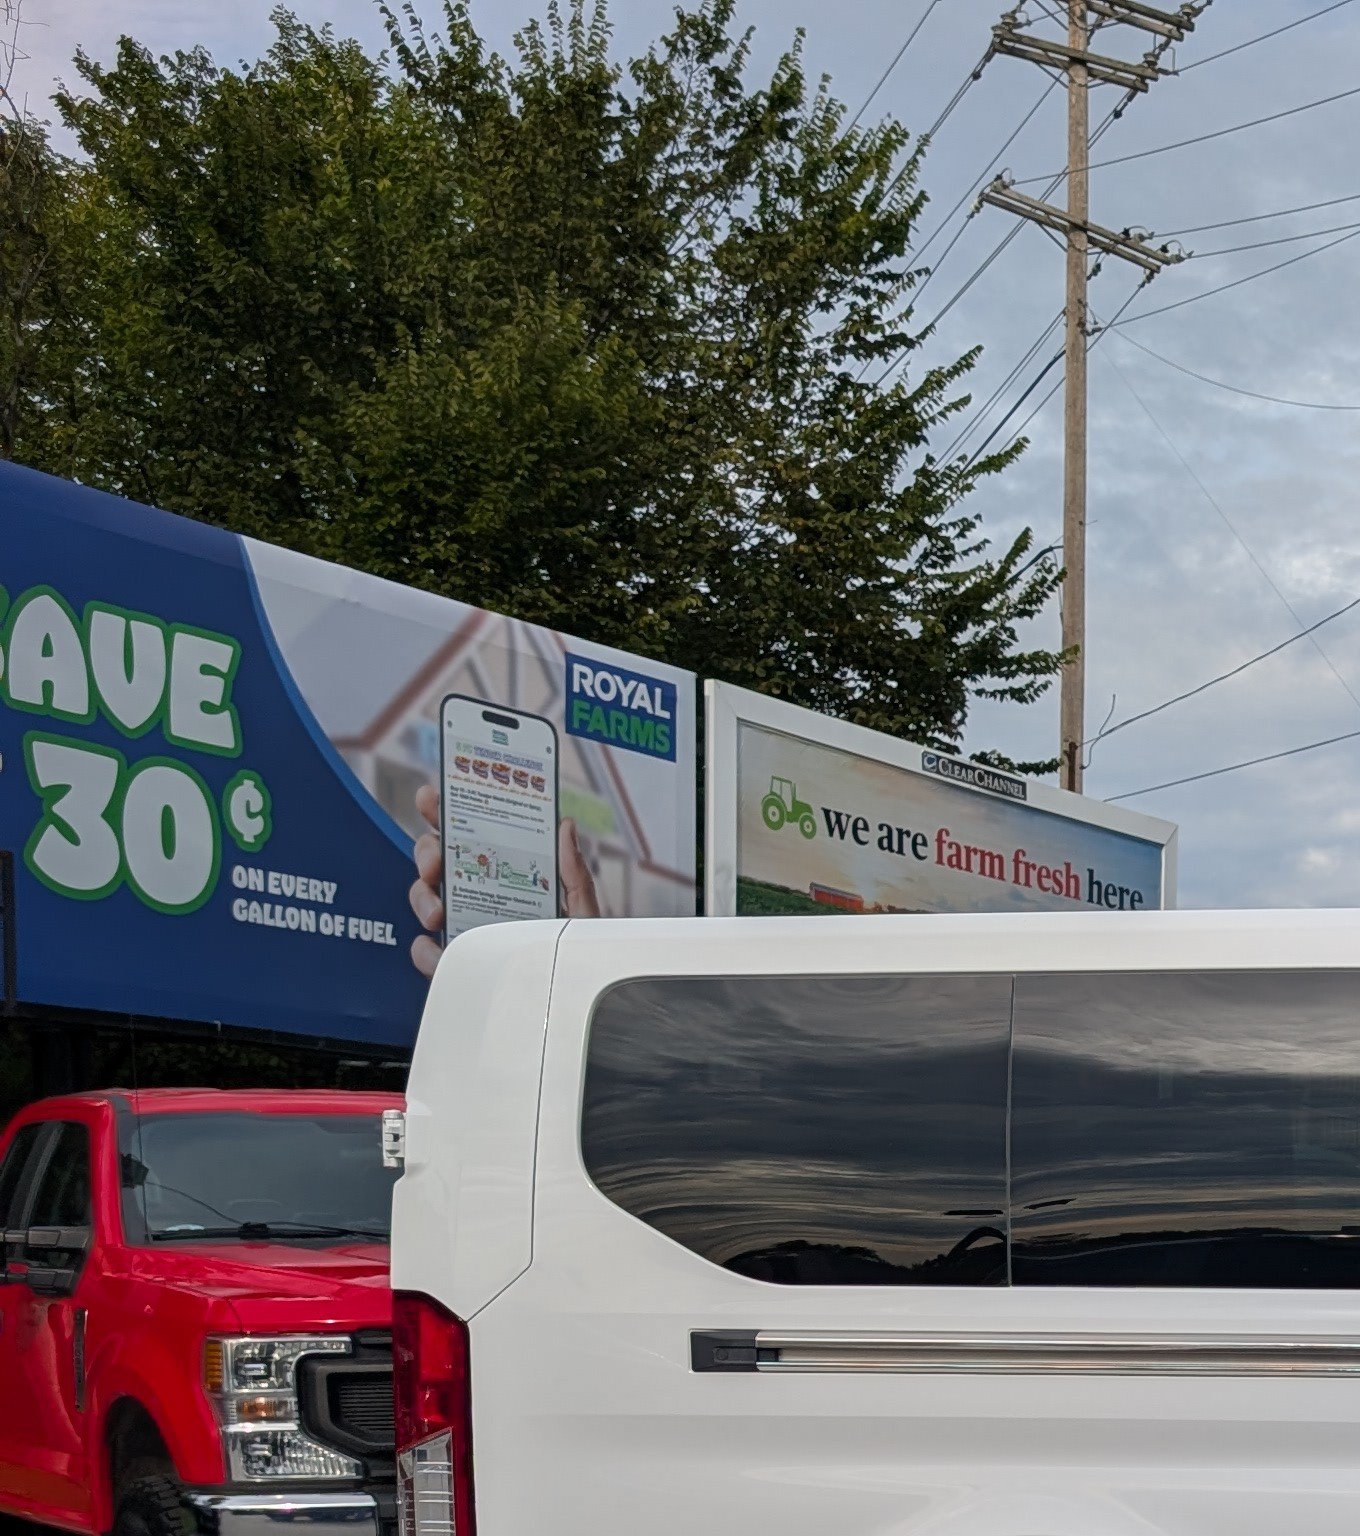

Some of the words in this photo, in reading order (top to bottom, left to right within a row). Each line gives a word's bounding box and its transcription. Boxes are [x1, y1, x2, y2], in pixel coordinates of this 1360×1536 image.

[0, 590, 238, 752] AVE
[572, 662, 671, 720] ROYAL
[572, 698, 671, 754] FARMS
[231, 864, 265, 893] ON
[267, 870, 338, 905] EVERY
[820, 806, 870, 846] we
[877, 822, 929, 861] are
[934, 827, 1007, 882] farm
[1012, 848, 1082, 901] fresh
[1086, 867, 1144, 910] here
[231, 897, 317, 934] GALLON
[319, 911, 346, 938] OF
[348, 916, 398, 947] FUEL
